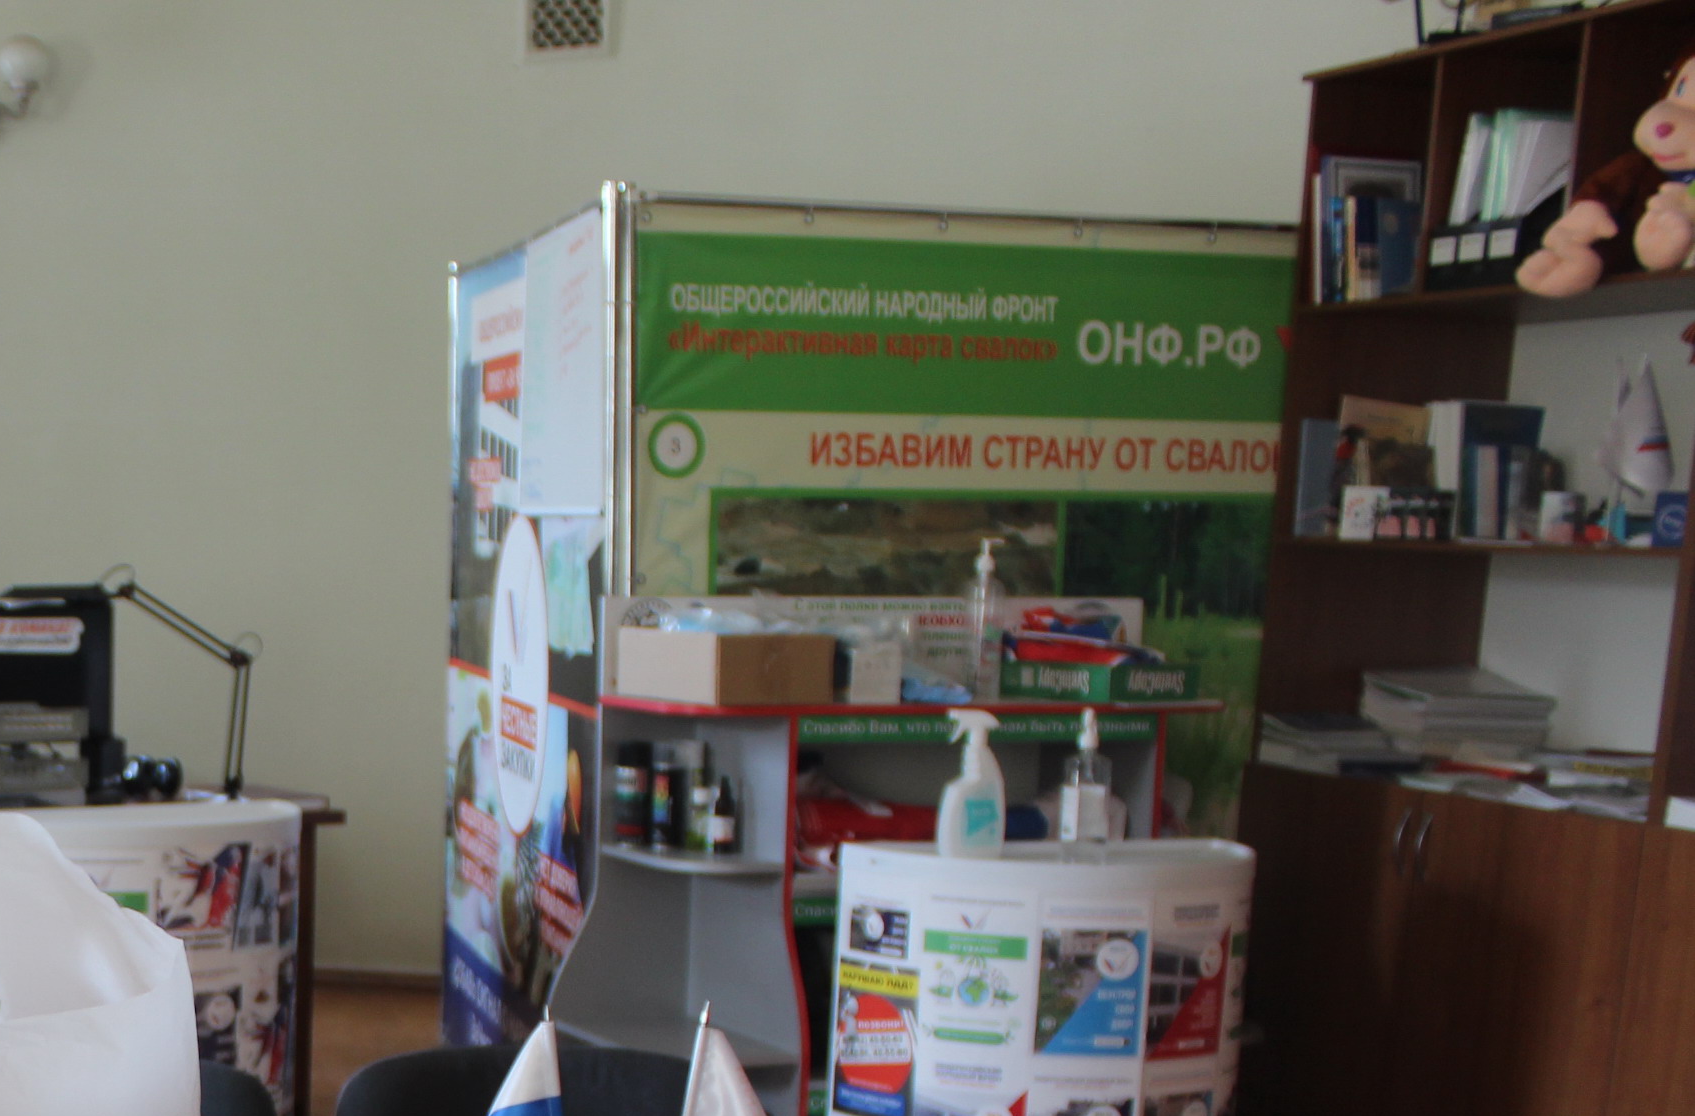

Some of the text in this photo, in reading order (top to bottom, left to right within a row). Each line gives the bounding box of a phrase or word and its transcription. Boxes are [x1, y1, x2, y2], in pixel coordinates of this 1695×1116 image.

[670, 281, 1058, 323] ОБЩЕРОССИЙСКИЙ НАРОДНЫЙ ФРОНТ
[668, 321, 1058, 364] «Интерактивная карта свалок»
[1077, 320, 1261, 368] ОНФ.РФ
[810, 432, 973, 468] ИЗБАВИМ
[983, 434, 1107, 471] СТРАНУ
[1115, 438, 1157, 471] ОТ
